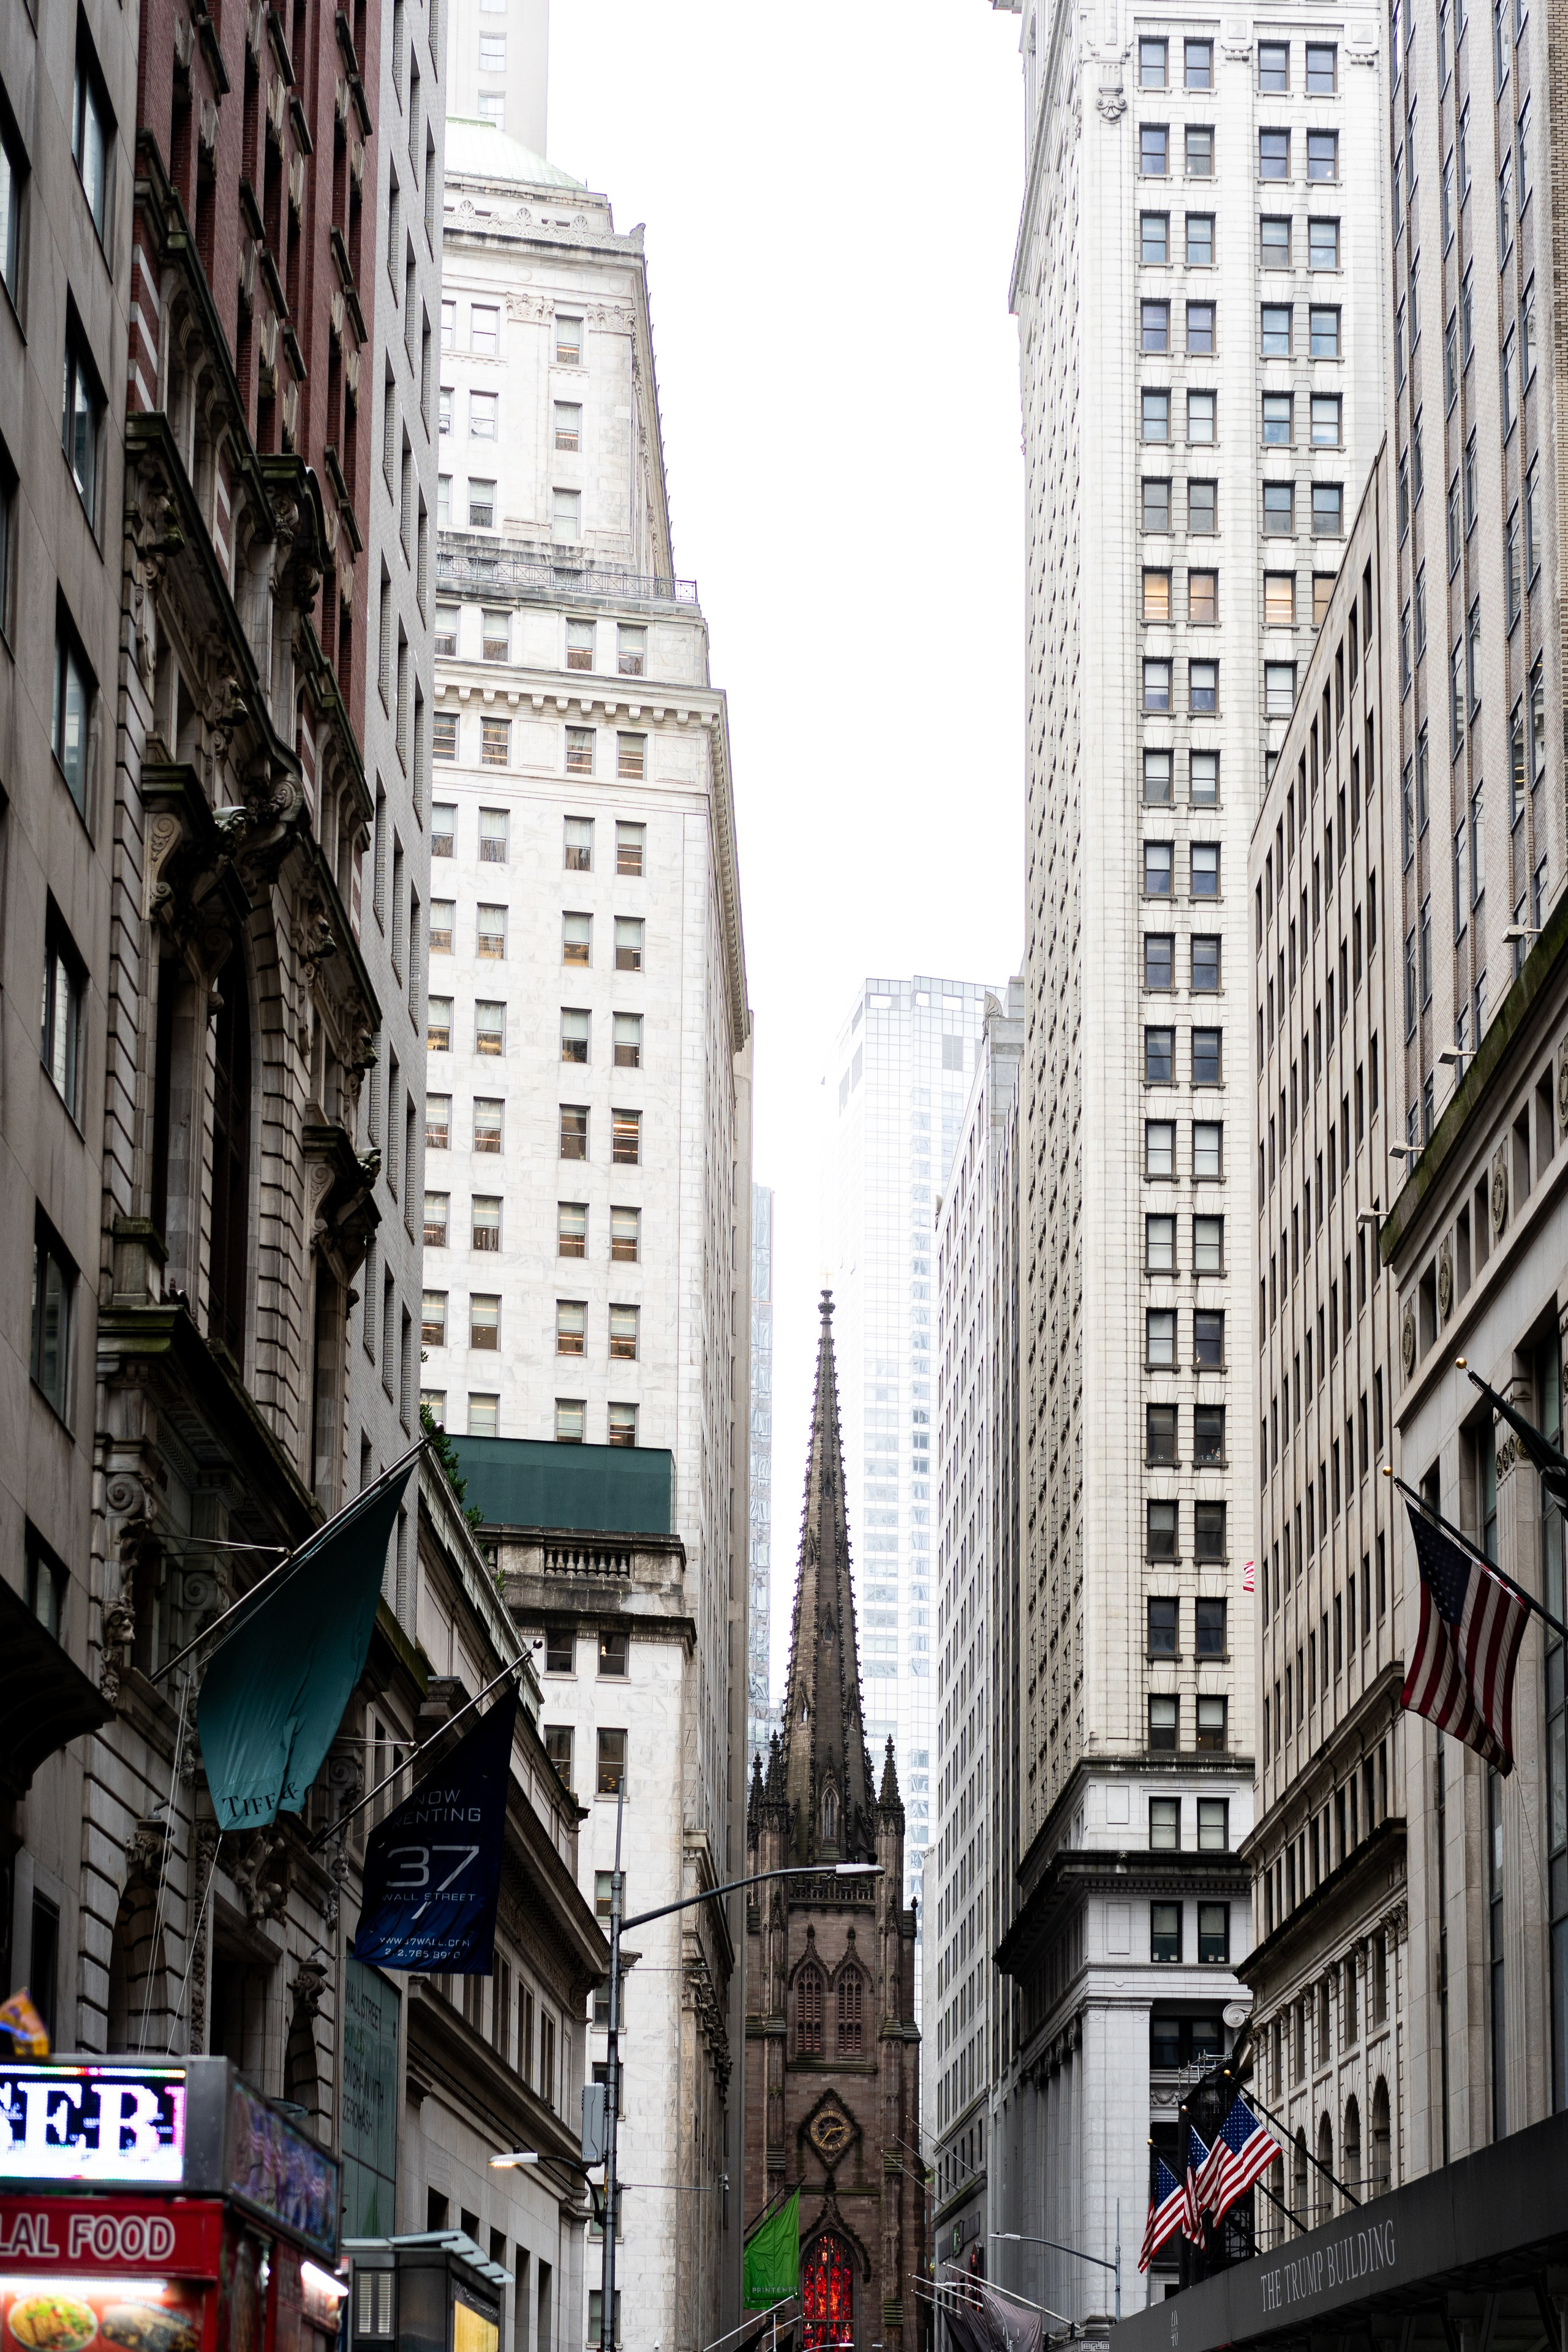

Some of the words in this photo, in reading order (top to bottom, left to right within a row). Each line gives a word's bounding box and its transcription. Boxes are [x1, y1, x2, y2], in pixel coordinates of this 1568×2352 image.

[392, 1808, 481, 1829] RENTING
[413, 1789, 461, 1806] NOW
[386, 1845, 480, 1919] 37
[424, 1893, 476, 1901] STREET
[385, 1948, 461, 1959] 22.785.890
[345, 1979, 361, 2017] WALL
[361, 1992, 382, 2032] STREET
[344, 2016, 365, 2056] BUILDS
[342, 2093, 372, 2138] ZEROHASH
[67, 2214, 175, 2260] FOOD
[1261, 2269, 1282, 2312] THE
[1284, 2250, 1323, 2304] TRUMP
[1326, 2218, 1396, 2288] BUILDING
